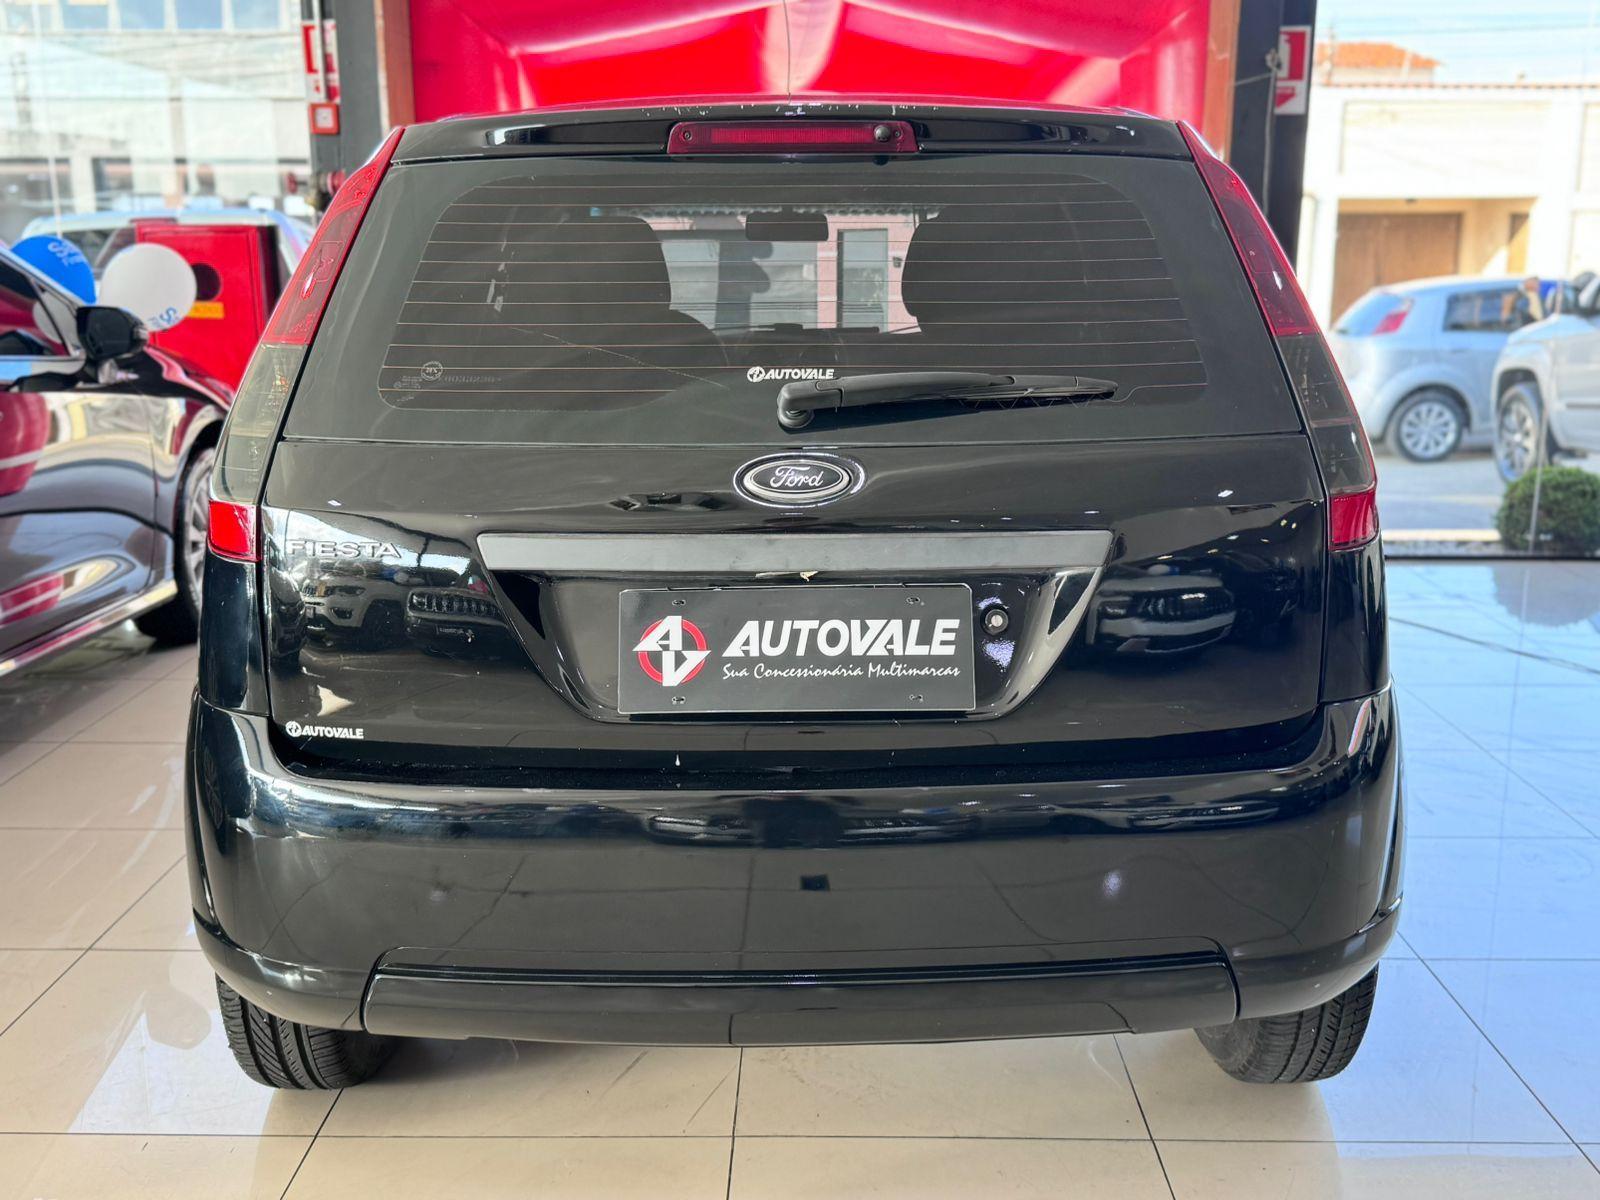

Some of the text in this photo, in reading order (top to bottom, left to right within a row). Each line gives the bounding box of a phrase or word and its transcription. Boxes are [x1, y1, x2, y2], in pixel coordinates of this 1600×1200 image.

[764, 368, 835, 380] AUTOVALE
[769, 465, 824, 488] Ford
[286, 540, 402, 559] FIESTA
[721, 618, 960, 658] AUTOVALE
[722, 661, 961, 680] Sua Concessionária Multimarcas
[301, 725, 364, 739] AUTOVALE
